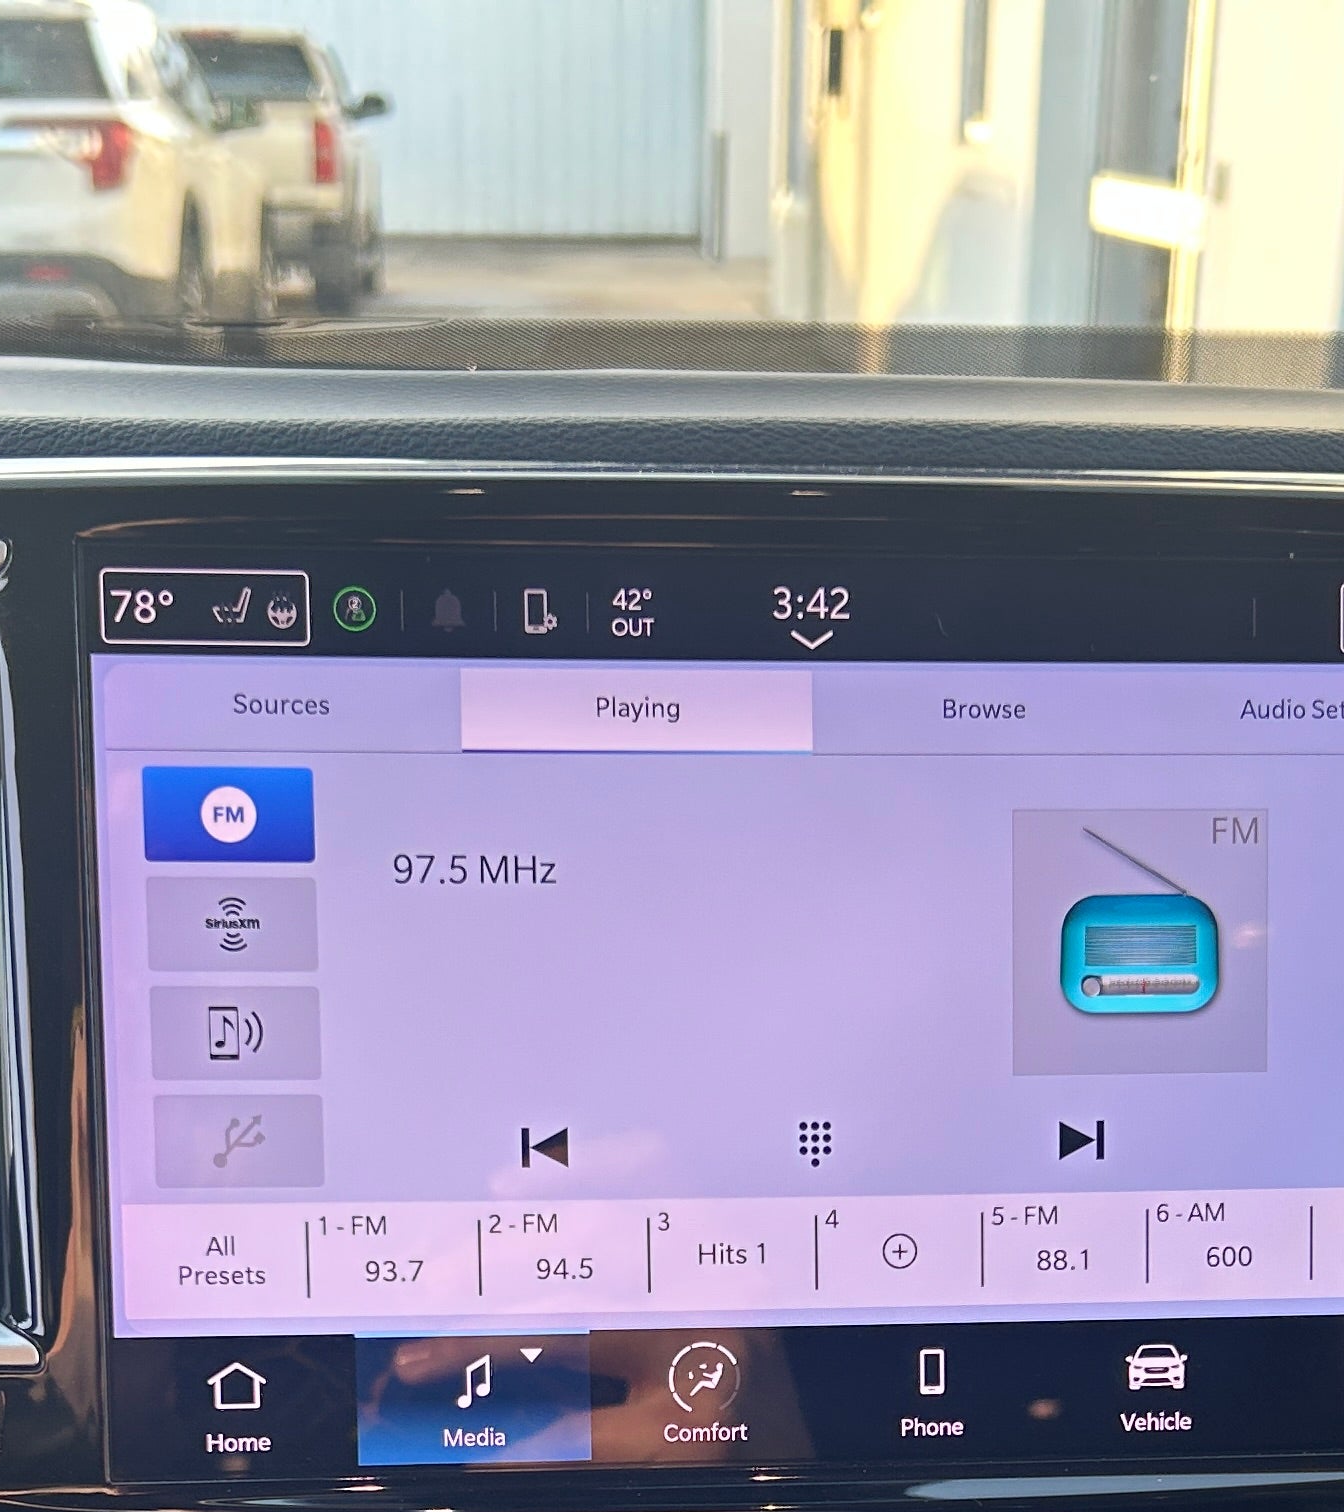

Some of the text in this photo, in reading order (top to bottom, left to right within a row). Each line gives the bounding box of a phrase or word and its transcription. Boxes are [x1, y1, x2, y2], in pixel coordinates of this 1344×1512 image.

[110, 589, 174, 625] 78°
[612, 588, 652, 611] 42°
[772, 587, 851, 621] 3:42
[611, 617, 655, 638] OUT
[233, 694, 330, 717] Sources
[596, 697, 681, 724] Playing
[942, 700, 1027, 721] Browse
[1240, 700, 1306, 721] Audio
[213, 806, 245, 823] FM
[1211, 818, 1259, 844] FM
[393, 855, 558, 886] 97.5 MHz
[488, 1215, 502, 1234] 2
[523, 1214, 559, 1234] FM
[657, 1212, 670, 1232] 3
[825, 1209, 839, 1229] 4
[991, 1207, 1005, 1226] 5
[1024, 1206, 1059, 1226] FM
[1156, 1203, 1169, 1223] 6
[1187, 1203, 1226, 1223] AM
[319, 1217, 328, 1236] 1
[351, 1215, 388, 1236] FM
[206, 1234, 236, 1257] All
[698, 1241, 768, 1265] Hits 1
[1036, 1248, 1091, 1272] 88.1
[1206, 1246, 1253, 1268] 600
[178, 1264, 267, 1287] Presets
[364, 1259, 424, 1283] 93.7
[536, 1257, 594, 1281] 94.5
[663, 1421, 748, 1444] Comfort
[900, 1416, 964, 1437] Phone
[1120, 1411, 1193, 1433] Vehicle
[206, 1432, 272, 1454] Home
[443, 1427, 506, 1448] Media
